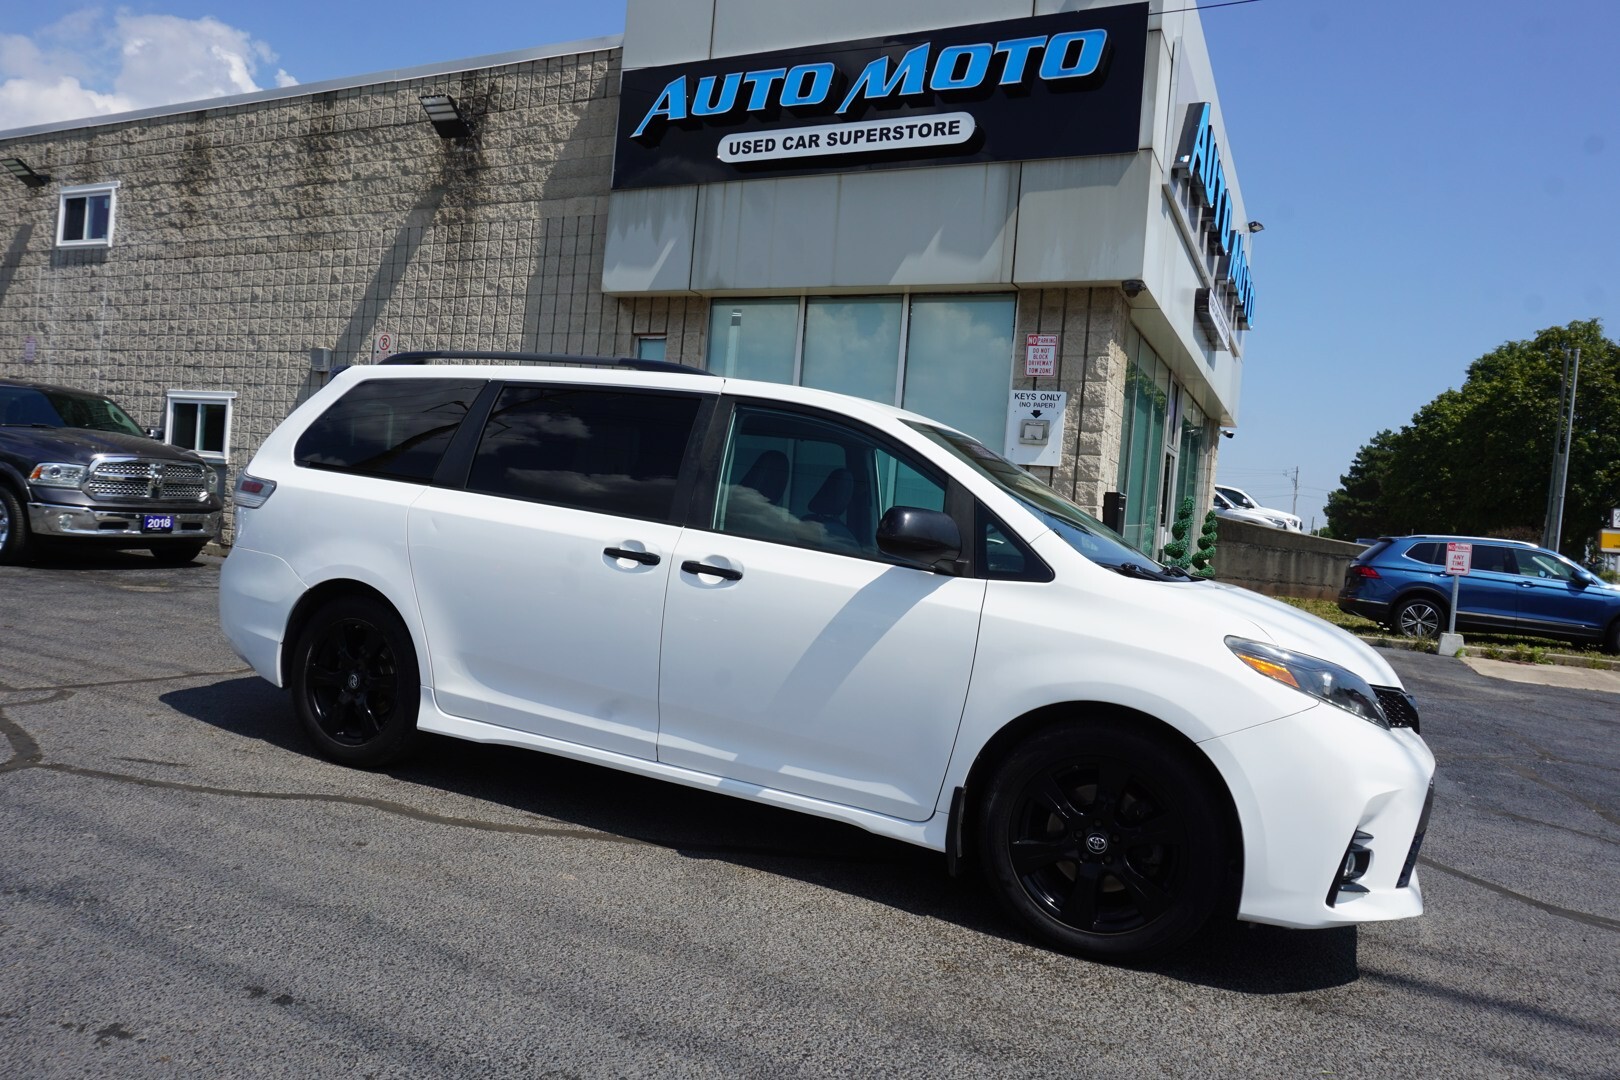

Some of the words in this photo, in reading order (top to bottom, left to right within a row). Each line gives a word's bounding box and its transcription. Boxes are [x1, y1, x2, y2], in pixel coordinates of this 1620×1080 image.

[630, 62, 835, 138] AUTO
[835, 28, 1108, 114] MOTO
[729, 138, 776, 156] USED
[782, 135, 820, 151] CAR
[826, 120, 960, 147] SUPERSTORE
[1188, 102, 1233, 256] AUTO
[1227, 229, 1256, 330] MOTO
[1028, 337, 1037, 345] NO
[1014, 393, 1037, 401] KEYS
[1040, 393, 1062, 402] ONLY
[147, 518, 171, 528] 2018
